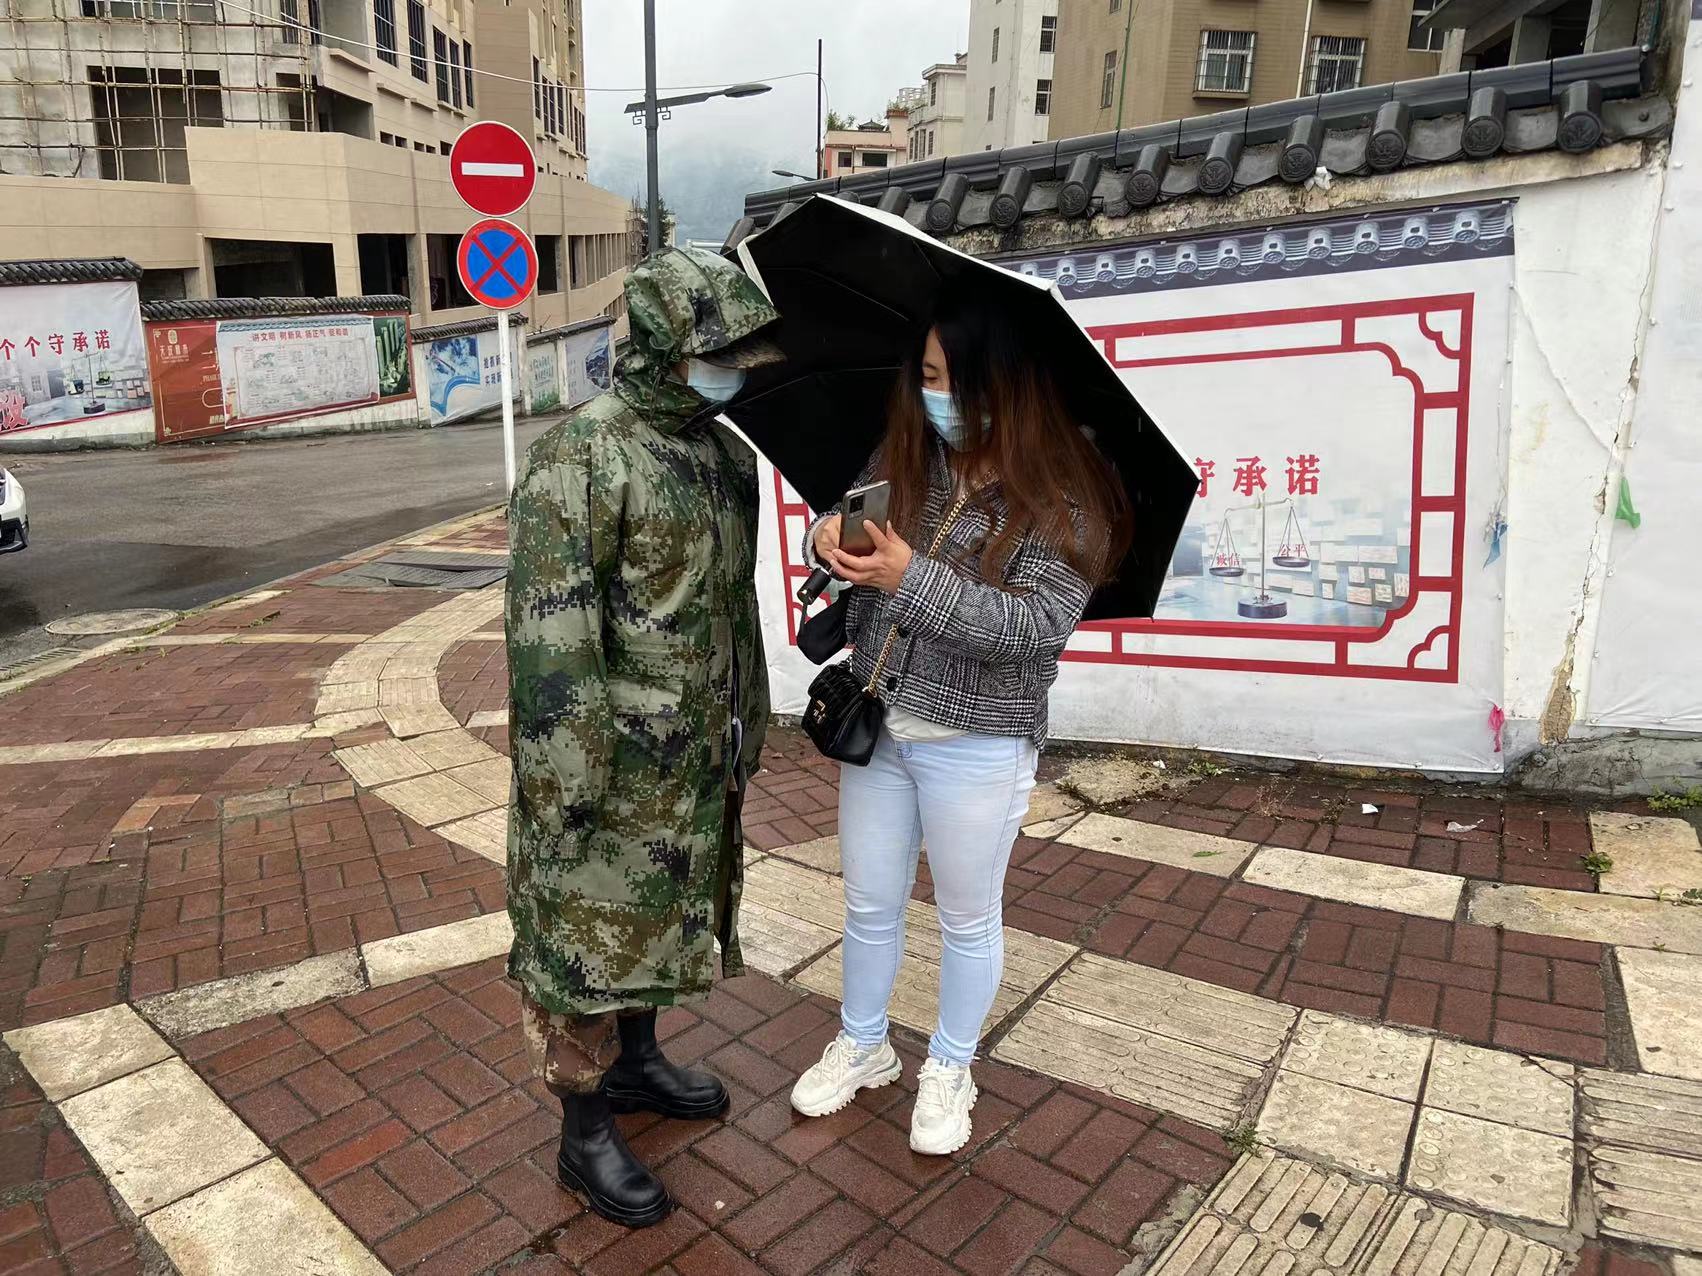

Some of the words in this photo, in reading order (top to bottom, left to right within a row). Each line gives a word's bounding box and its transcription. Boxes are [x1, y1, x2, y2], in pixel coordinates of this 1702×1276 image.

[0, 329, 111, 361] 个个守承诺
[1281, 543, 1306, 557] 公平
